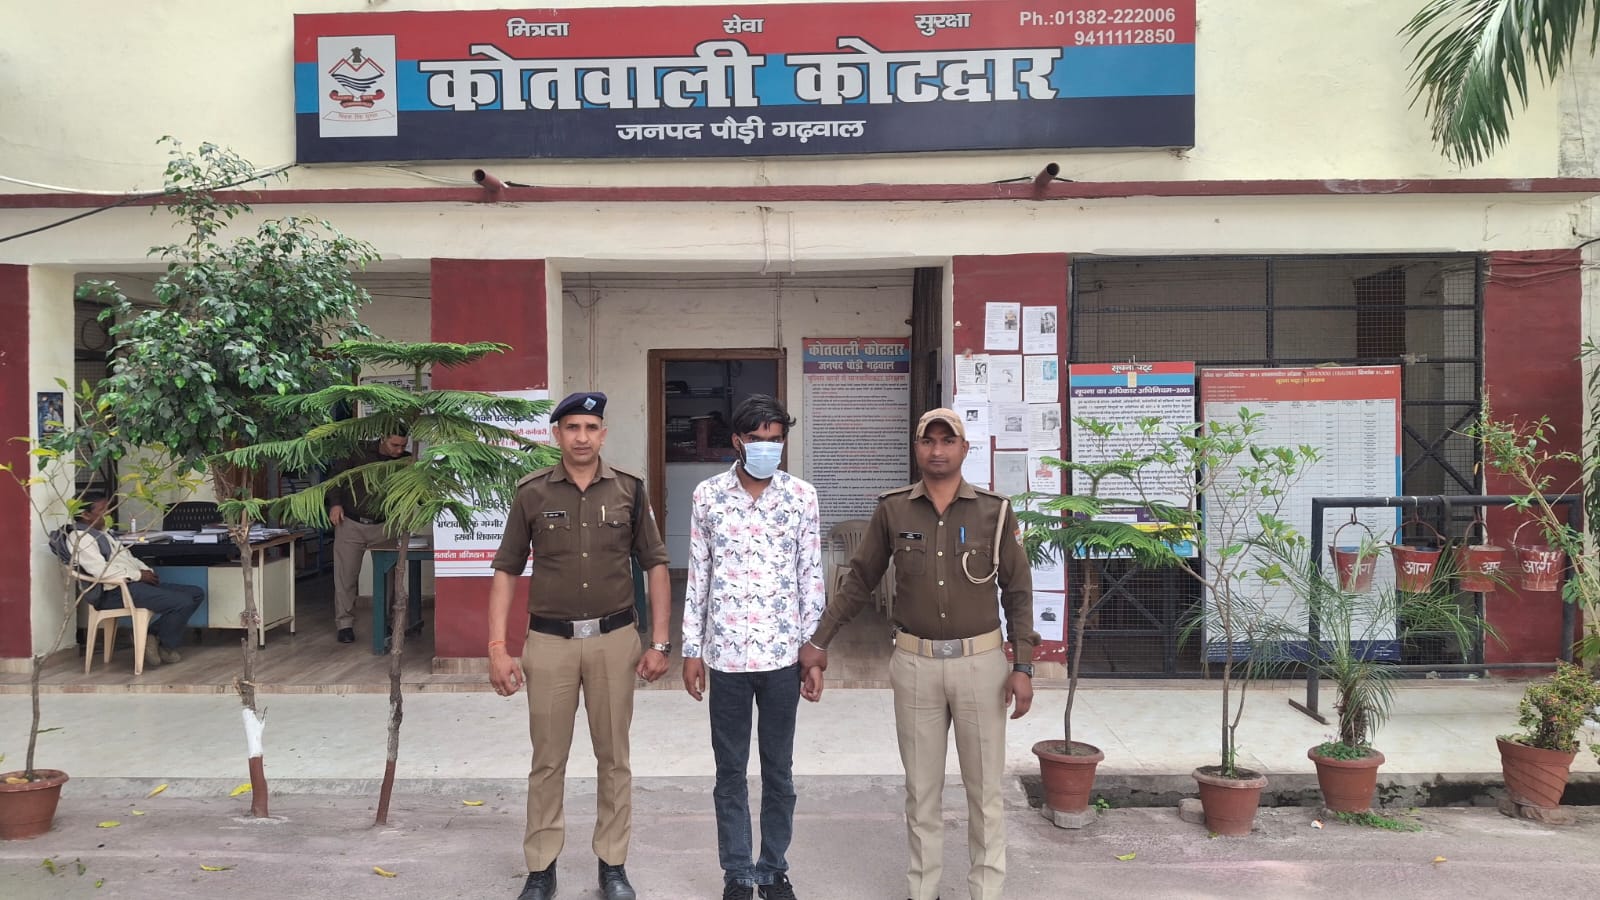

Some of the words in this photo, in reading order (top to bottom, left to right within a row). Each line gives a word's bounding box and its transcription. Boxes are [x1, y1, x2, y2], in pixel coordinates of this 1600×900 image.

[506, 18, 570, 37] मित्रता
[722, 15, 764, 34] सेवा
[914, 12, 970, 36] सुरक्षा
[1019, 8, 1176, 26] Ph.:01382-222006
[1074, 28, 1176, 45] 9411112850
[417, 39, 766, 111] कोतवाली
[785, 36, 1063, 105] कोटद्वार
[615, 122, 705, 141] जनपद
[710, 116, 765, 145] पौड़ी
[772, 119, 866, 143] गढ़वाल
[808, 341, 860, 356] कोतवाली
[818, 361, 844, 370] जनपद
[1075, 387, 1095, 397] सूचना
[1096, 386, 1106, 394] का
[1108, 385, 1137, 394] अधिकार
[1402, 561, 1432, 575] आग
